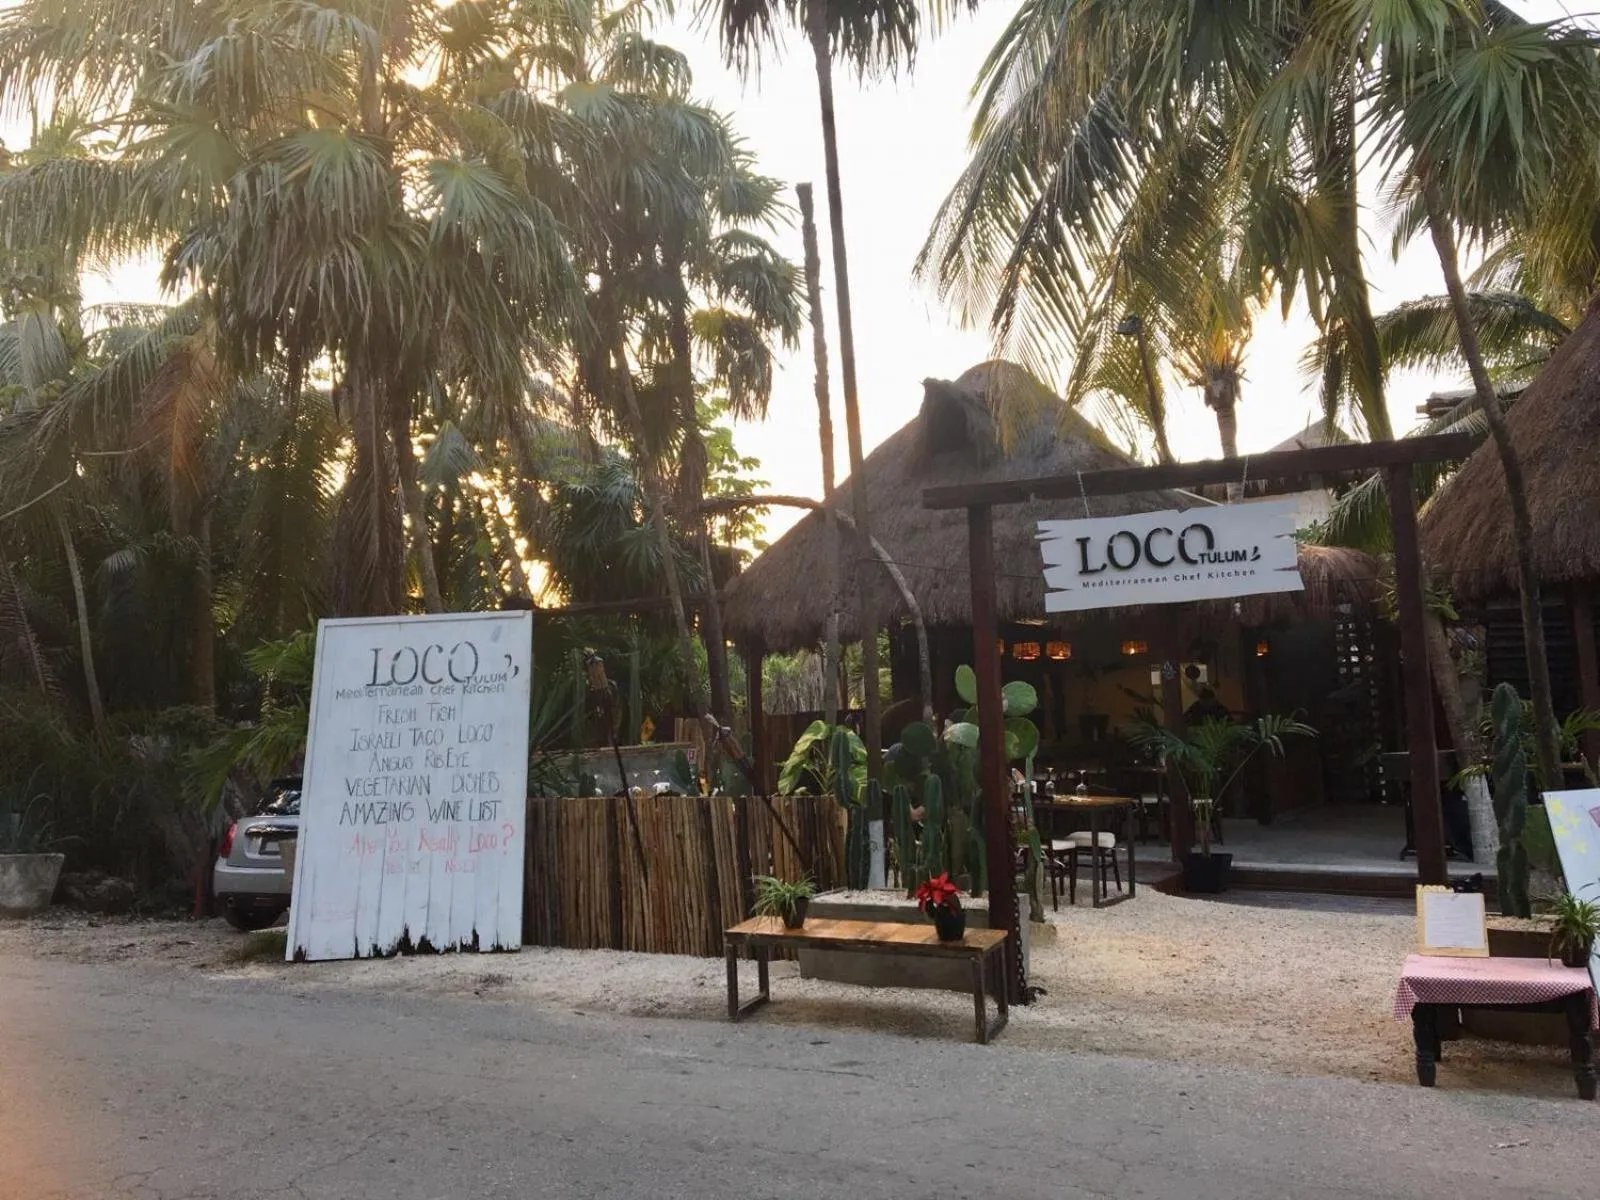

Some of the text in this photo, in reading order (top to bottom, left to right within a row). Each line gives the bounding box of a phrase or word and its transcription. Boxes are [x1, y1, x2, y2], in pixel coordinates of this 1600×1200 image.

[1075, 523, 1215, 575] LOCO
[1200, 549, 1247, 566] TULUM
[1082, 569, 1256, 589] Mediterranean Chef Kitchen
[366, 640, 478, 687] LOCO
[465, 674, 508, 685] TULUM
[409, 727, 444, 747] TACO
[459, 723, 494, 743] LOCO
[345, 775, 431, 797] VEGETARIAN
[339, 800, 502, 825] AMAZING WINE LIST
